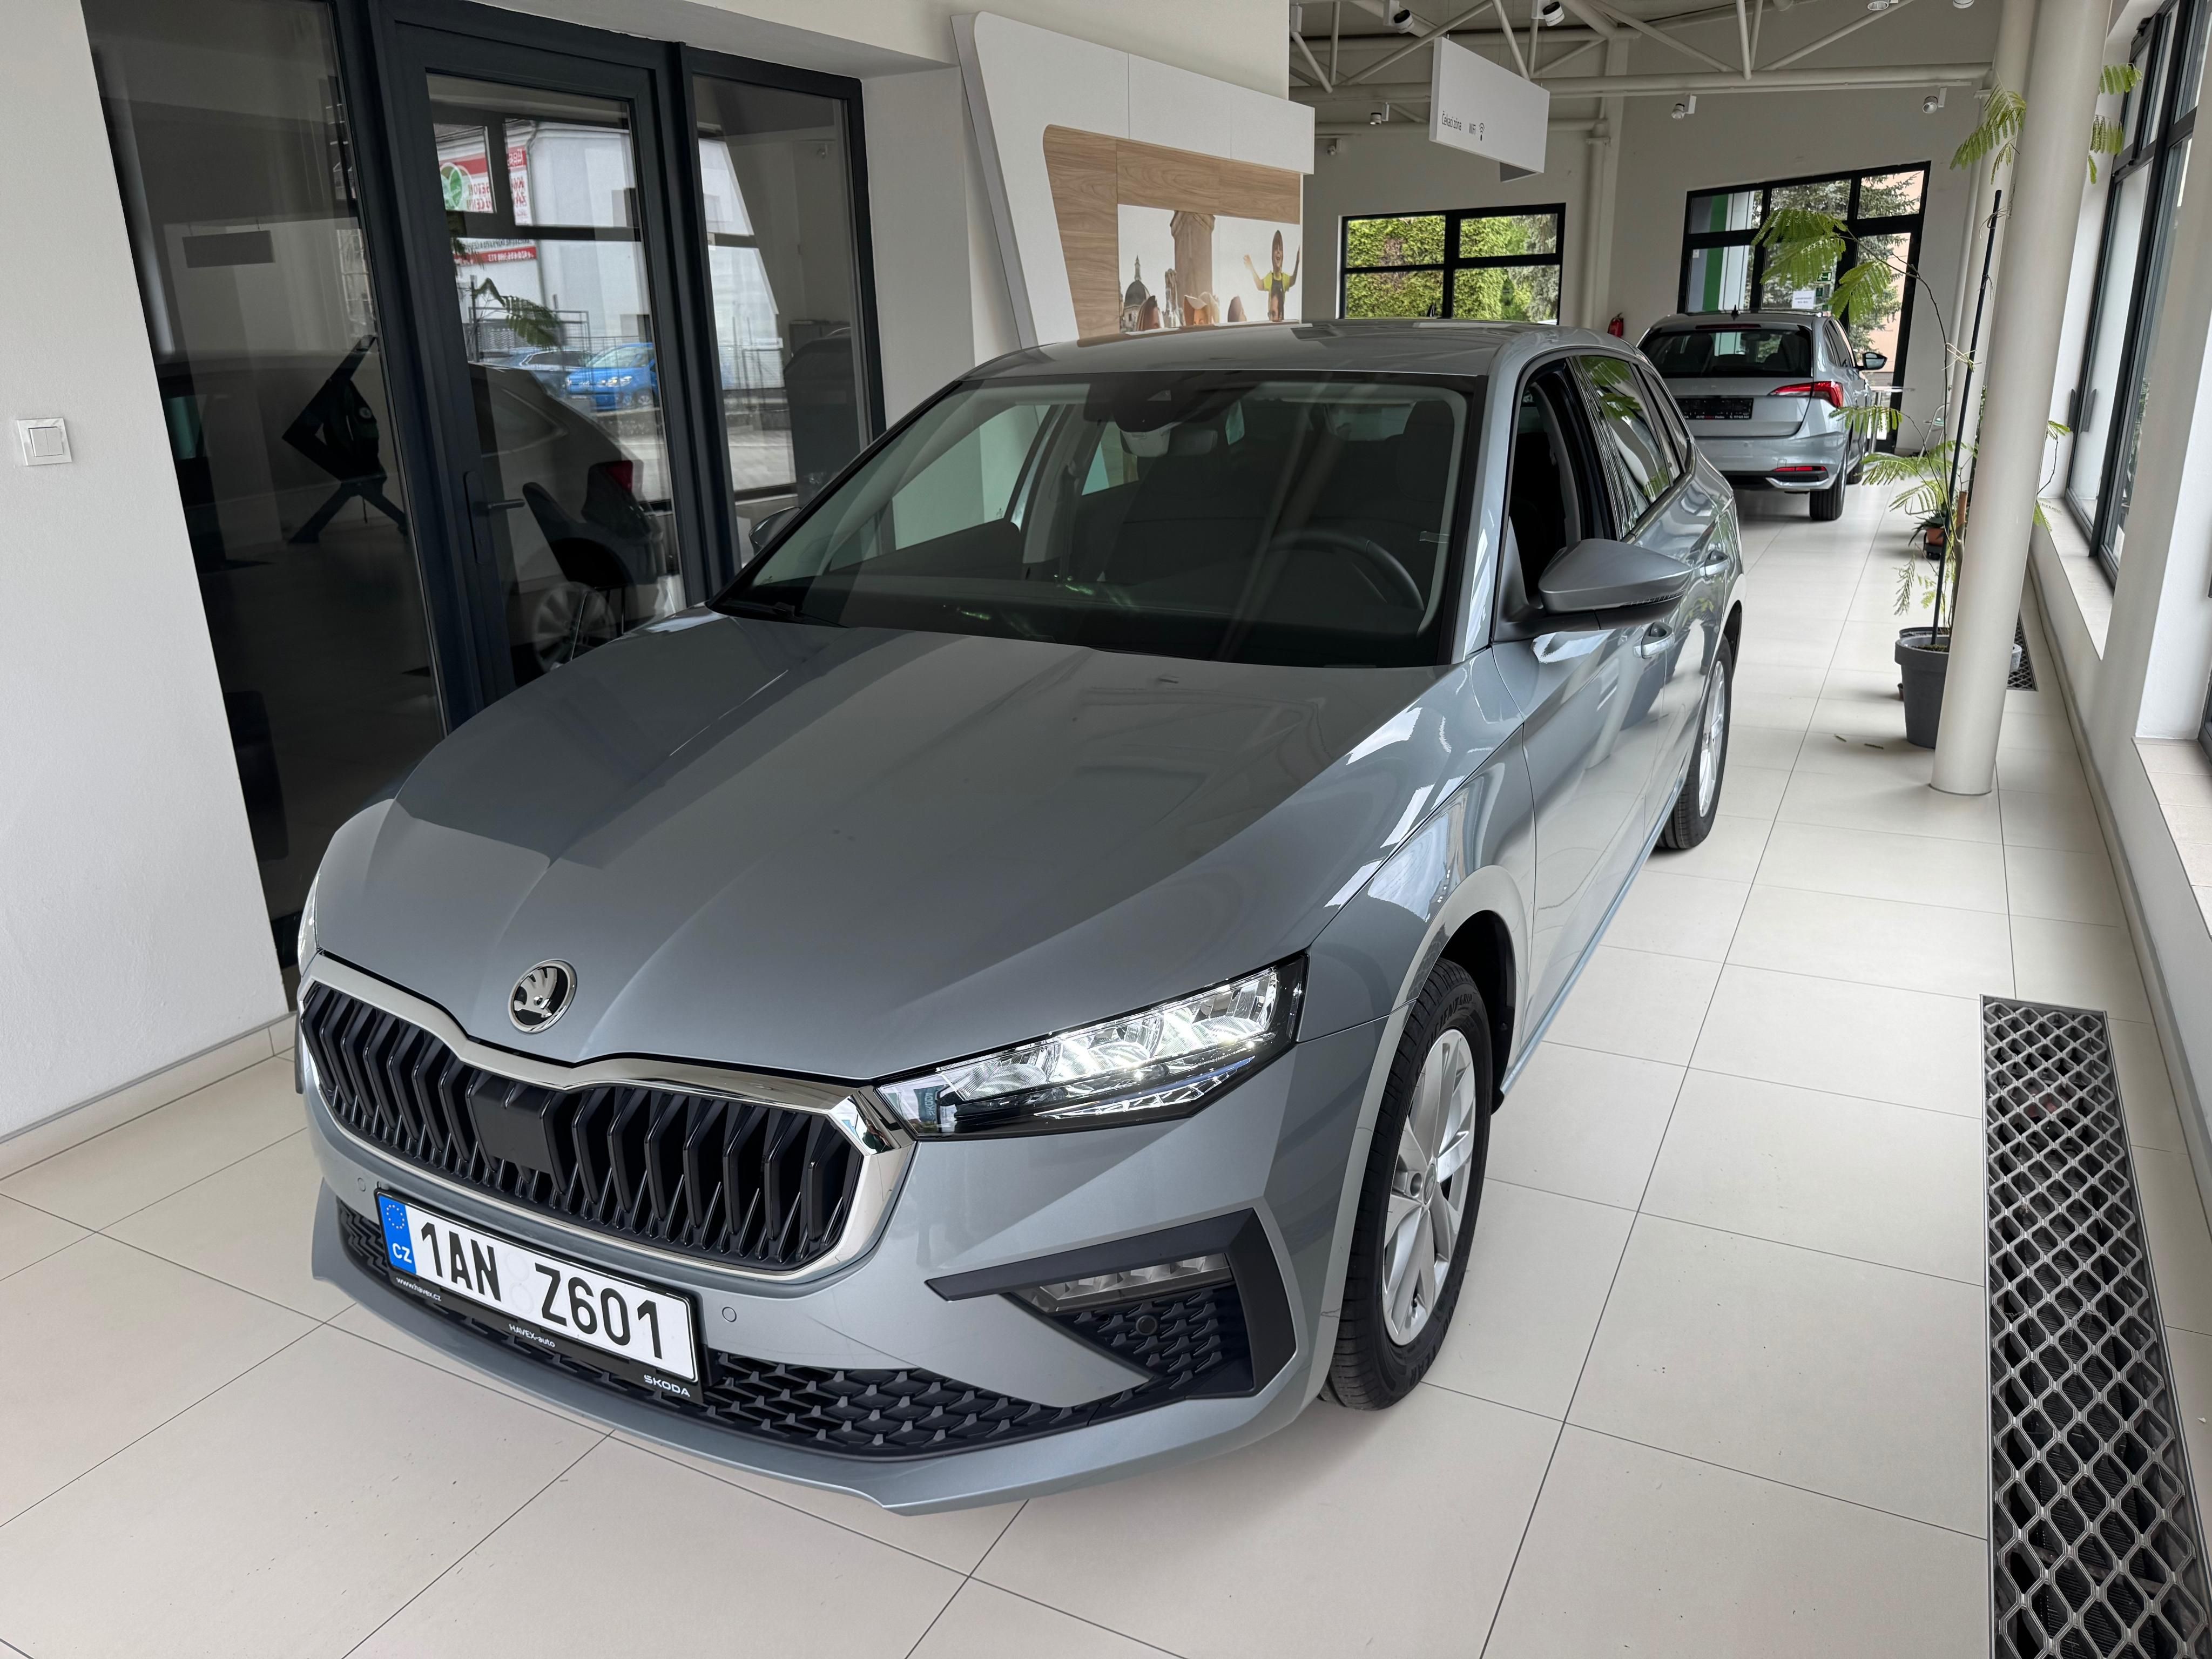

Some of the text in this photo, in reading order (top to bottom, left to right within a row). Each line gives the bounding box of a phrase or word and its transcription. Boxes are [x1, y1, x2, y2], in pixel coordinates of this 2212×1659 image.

[392, 1243, 413, 1264] CZ
[421, 1222, 662, 1360] 1AN Z601
[509, 1323, 556, 1347] HAVEX-auto
